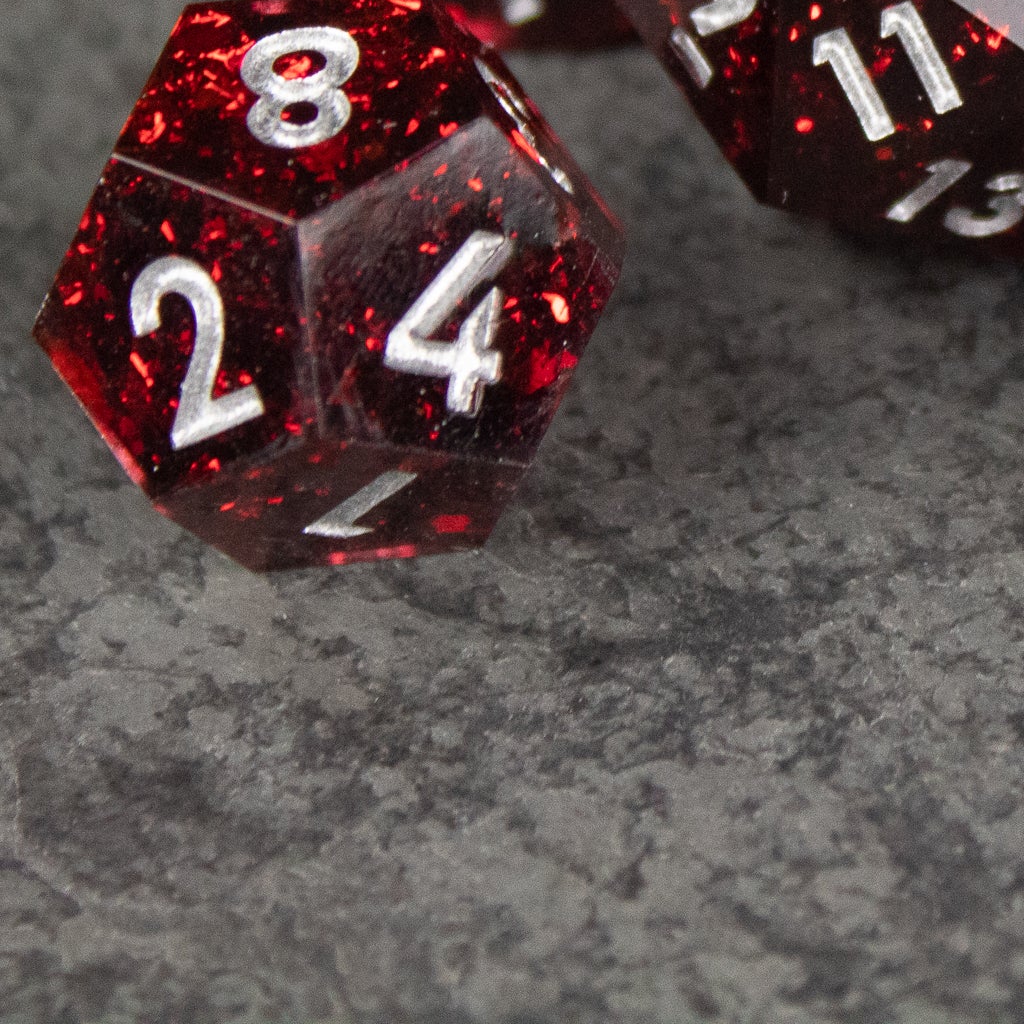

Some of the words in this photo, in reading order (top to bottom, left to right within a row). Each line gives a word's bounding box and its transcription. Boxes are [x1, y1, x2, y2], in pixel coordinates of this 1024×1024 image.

[240, 26, 360, 148] 8
[812, 0, 964, 142] 11
[129, 256, 265, 450] 2
[384, 229, 504, 418] 4
